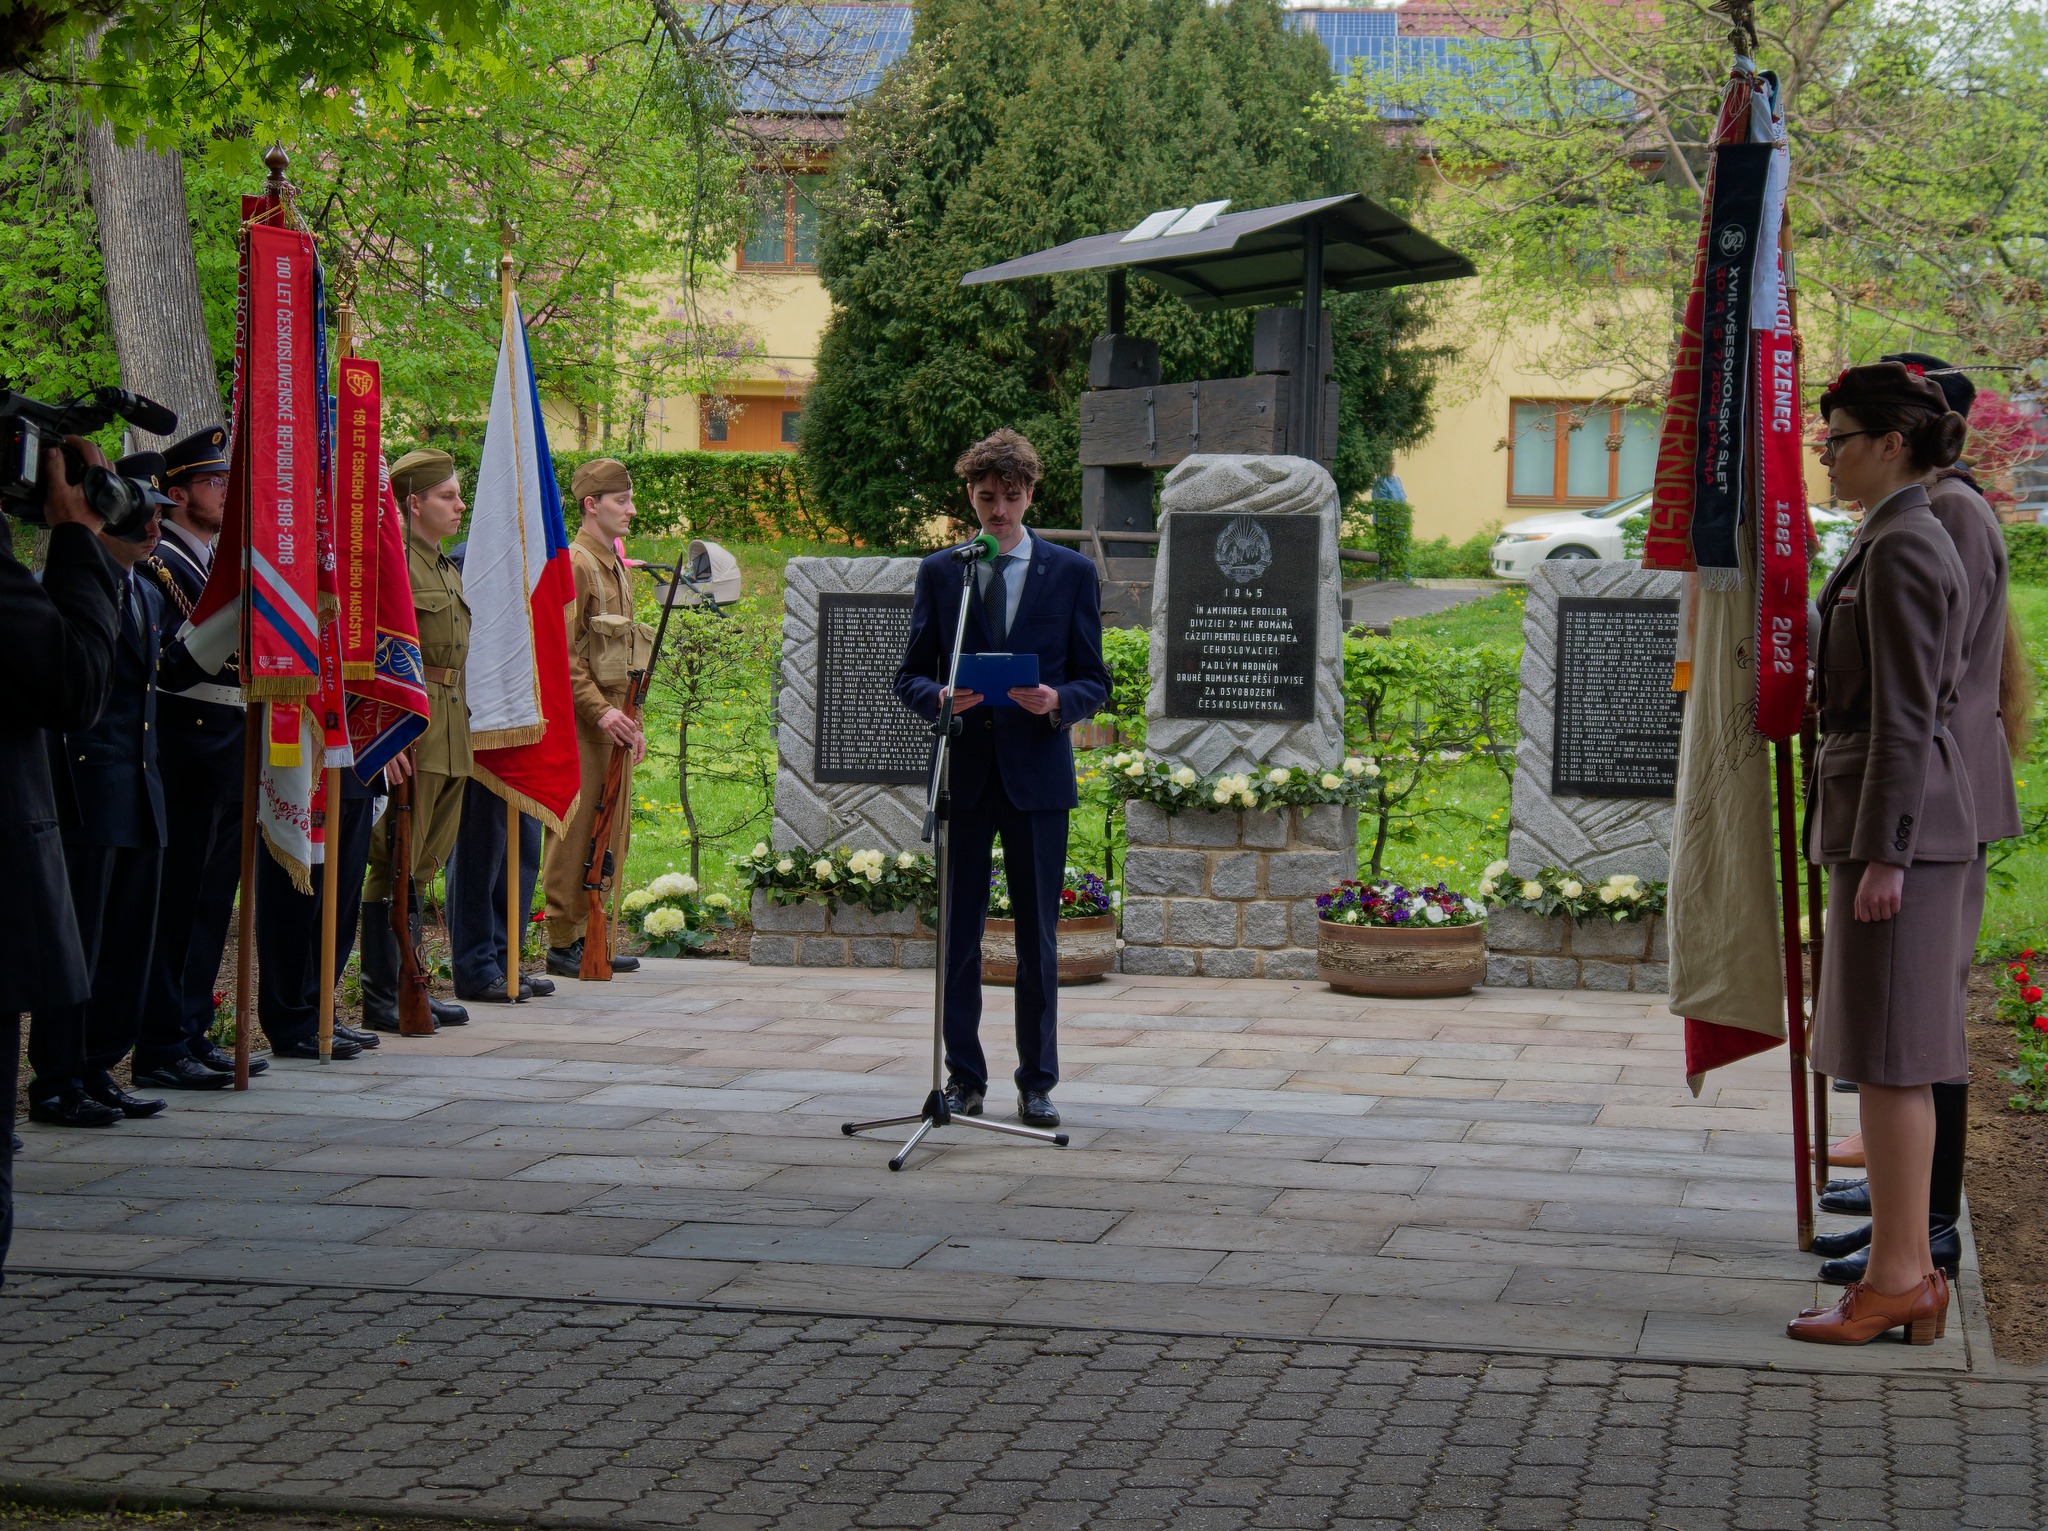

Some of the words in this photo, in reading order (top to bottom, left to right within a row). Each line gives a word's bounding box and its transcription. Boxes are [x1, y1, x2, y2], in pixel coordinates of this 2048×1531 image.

[277, 256, 291, 278] 100
[277, 282, 291, 306] LET
[1727, 266, 1740, 306] XVII.
[277, 309, 295, 420] ČESKOSLOVENSKÉ
[1719, 310, 1737, 444] VŠESOKOLSKÝ
[1772, 350, 1792, 433] BZENEC
[353, 408, 366, 426] 150
[353, 429, 366, 448] LET
[277, 425, 293, 493] REPUBLIKY
[1705, 421, 1717, 484] PRAHA
[351, 451, 368, 500] ČESKÉHO
[1717, 450, 1730, 493] SLET
[1775, 500, 1791, 556] 1882
[350, 502, 365, 588] DOBROVOLNÉHO
[1224, 588, 1263, 598] 1945
[348, 591, 364, 649] HASIČSTVA
[1207, 606, 1248, 615] AMINTIREA
[1251, 607, 1288, 616] EROILOR
[1190, 619, 1225, 628] DIVIZIEI
[1214, 632, 1240, 641] PENTRU
[1243, 633, 1298, 643] ELIBERAREA
[1772, 617, 1794, 674] 2022
[1203, 645, 1280, 655] CEHOSLOVACIEI.
[1201, 658, 1238, 670] PADLÝM
[1242, 660, 1278, 670] HRDINŮM
[1176, 671, 1202, 682] DRUHÉ
[1205, 673, 1250, 683] RUMUNSKÉ
[1252, 673, 1271, 684] PĚŠÍ
[1274, 675, 1304, 685] DIVISE
[1205, 687, 1215, 695] ZA
[1220, 686, 1275, 697] OSVOBOZENÍ
[1198, 697, 1286, 711] ČESKOSLOVENSKA.
